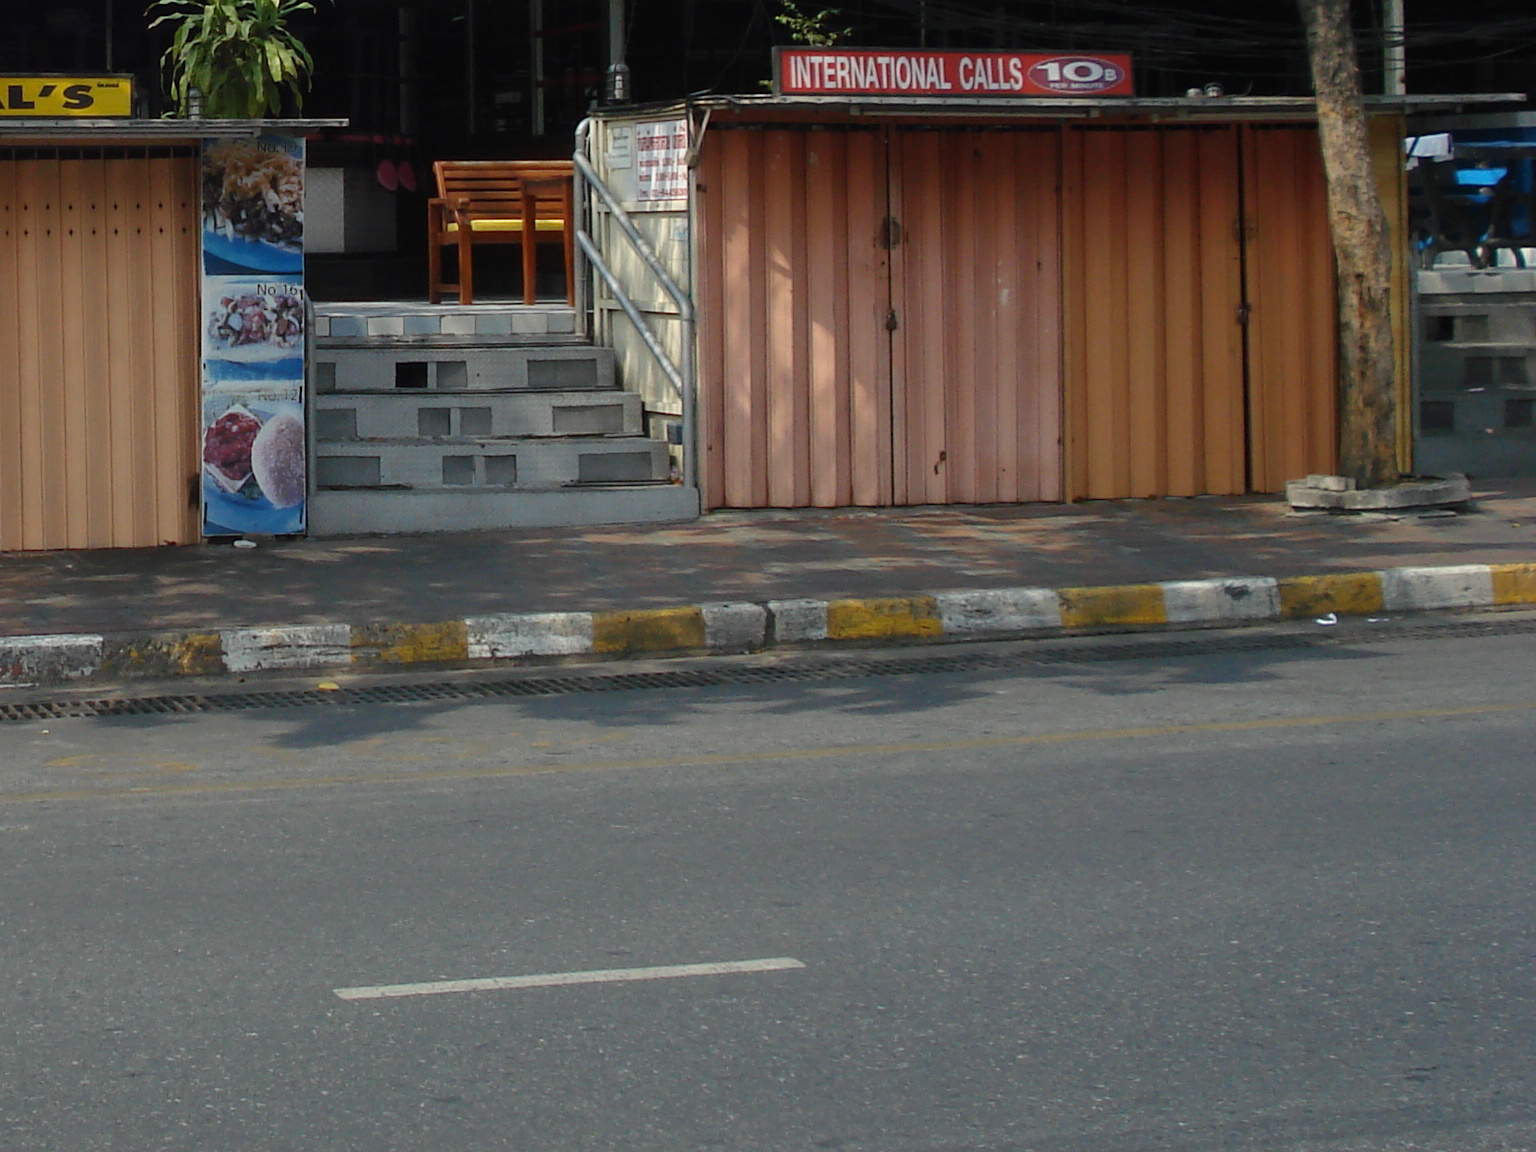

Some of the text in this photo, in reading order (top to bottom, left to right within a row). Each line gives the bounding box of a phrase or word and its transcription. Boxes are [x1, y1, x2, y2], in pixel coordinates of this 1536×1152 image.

[790, 55, 952, 90] INTERNATIONAL
[959, 56, 1024, 91] CALLS
[283, 282, 298, 296] 16
